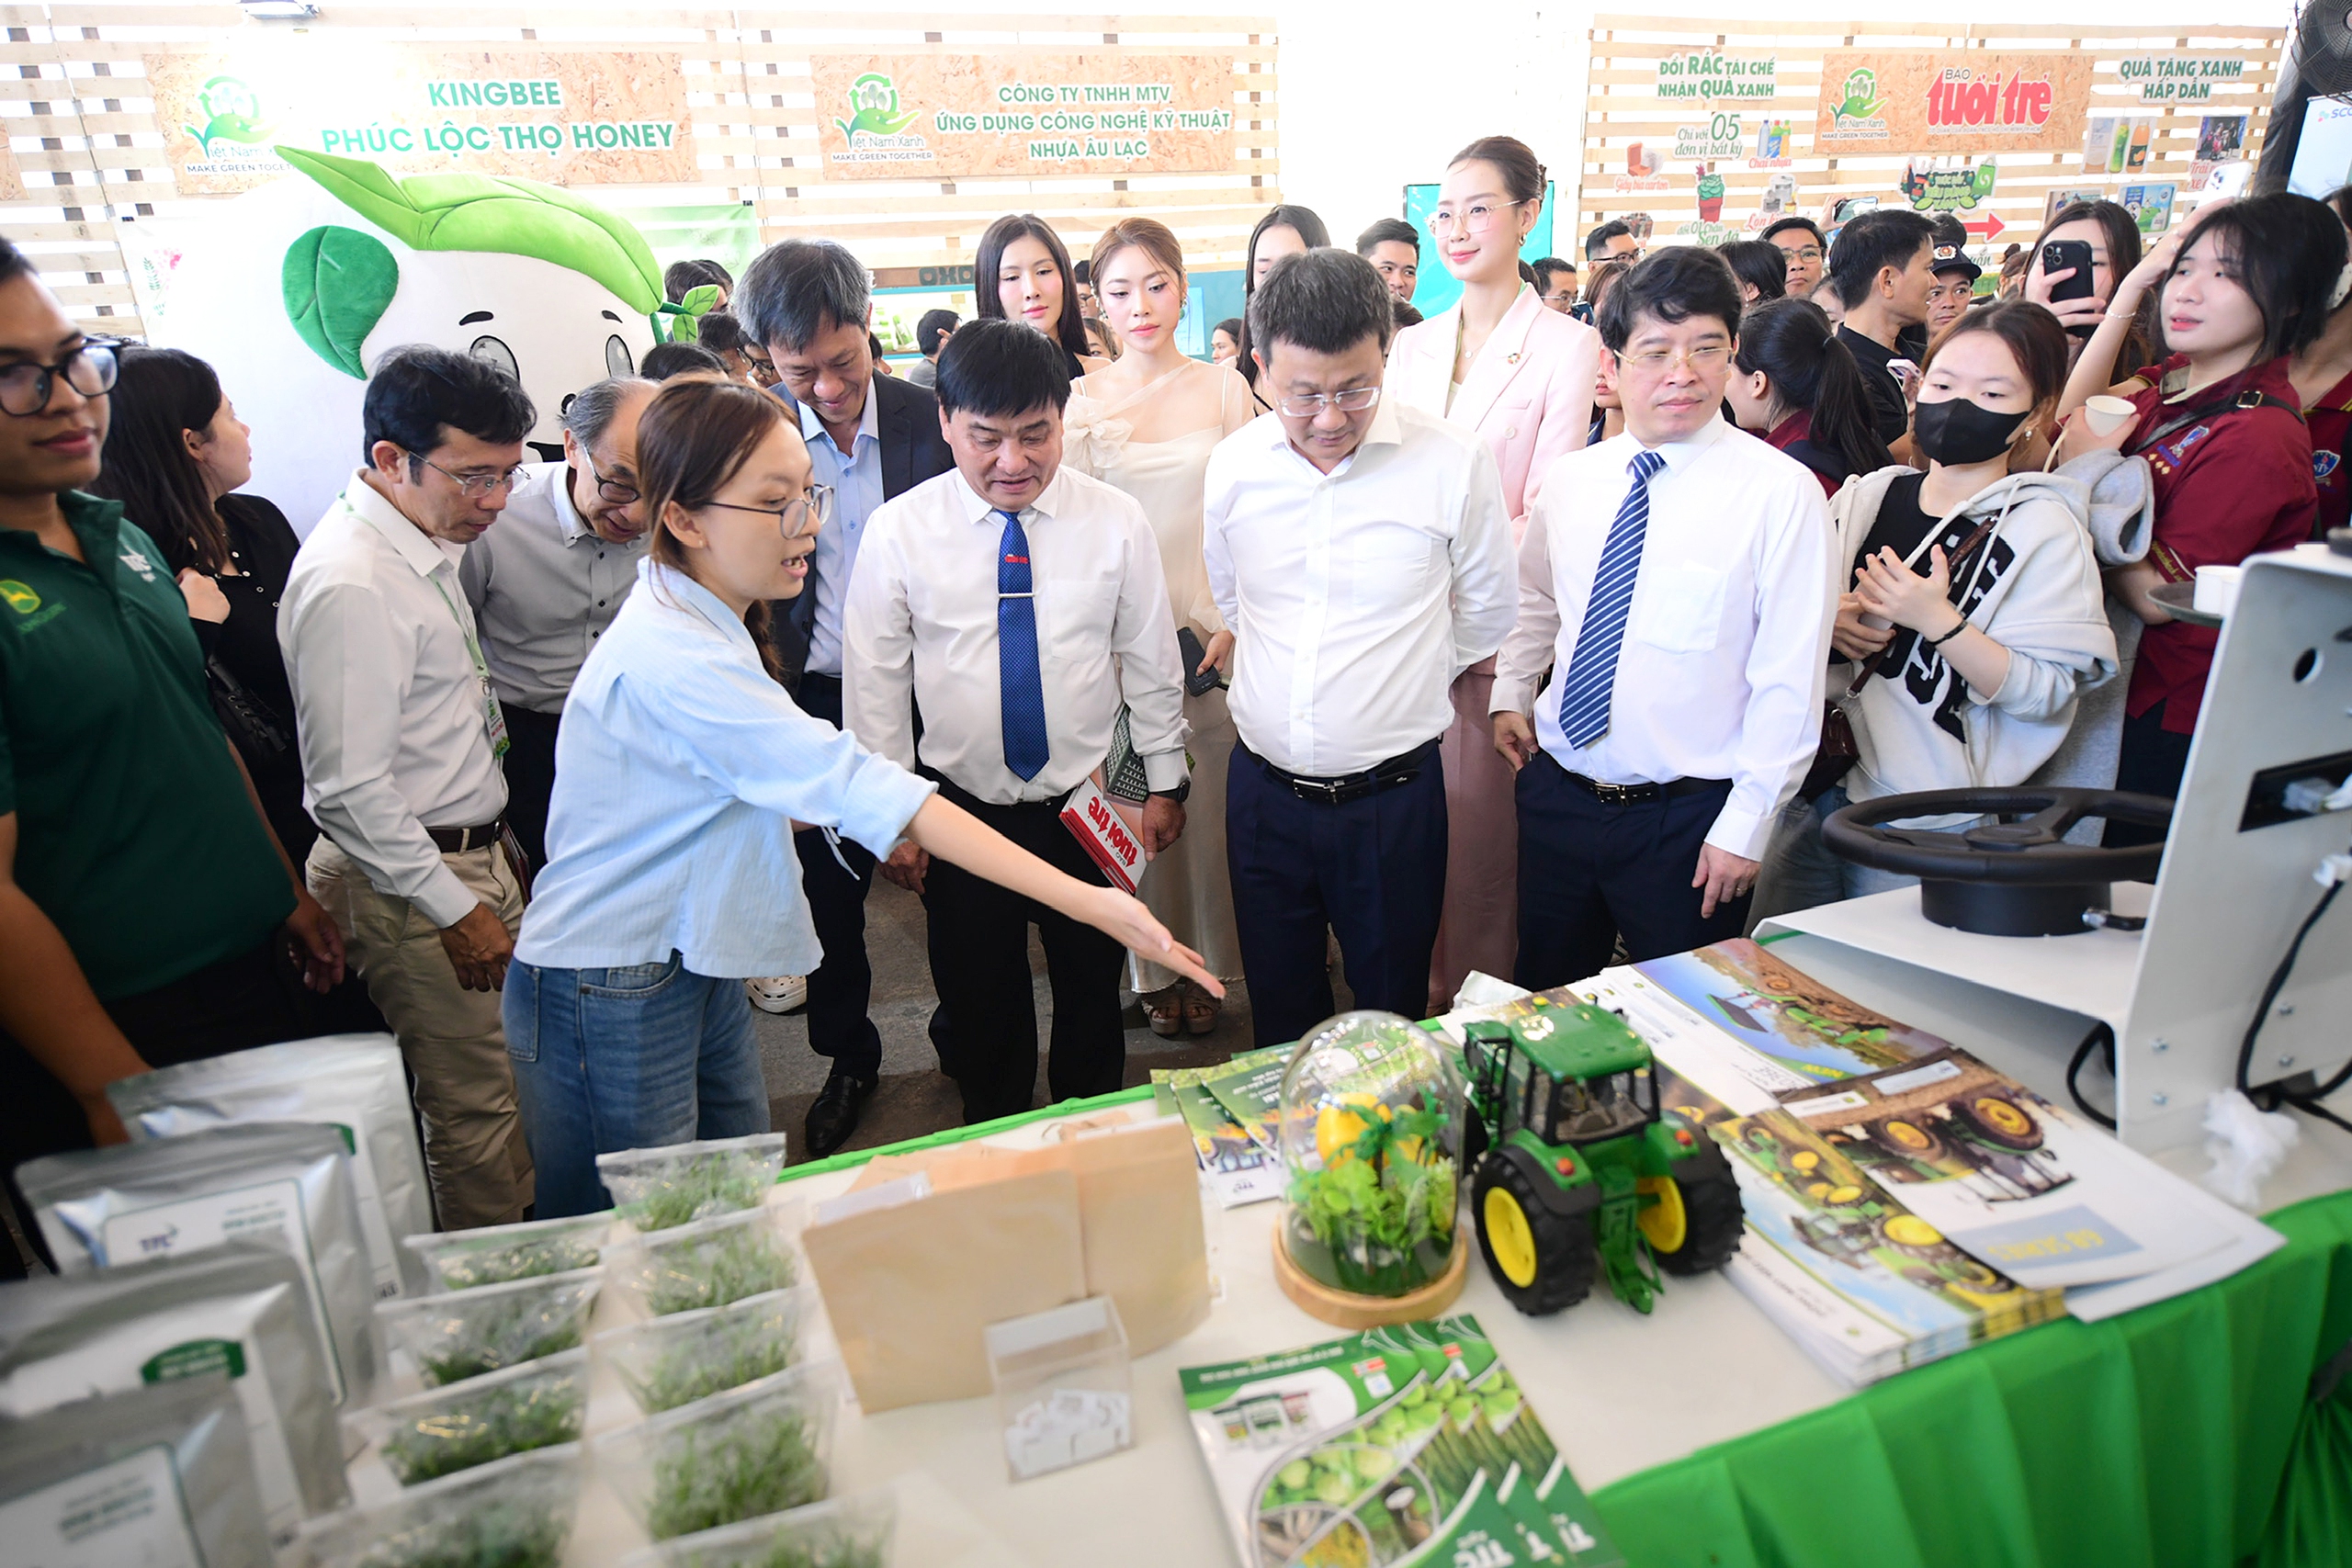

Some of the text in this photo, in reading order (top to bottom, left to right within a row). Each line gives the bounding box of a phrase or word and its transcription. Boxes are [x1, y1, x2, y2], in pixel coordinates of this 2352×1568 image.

[1688, 51, 1724, 75] RÁC
[1724, 59, 1747, 75] TÁI
[1749, 56, 1776, 75] CHẾ
[2120, 57, 2152, 80] QUÀ
[2199, 61, 2243, 77] XANH
[428, 82, 561, 107] KINGBEE
[999, 83, 1170, 102] CÔNG TY TNHH MTV
[1657, 76, 1775, 100] NHẬN QUÀ XANH
[2001, 69, 2052, 126] trẻ
[2143, 77, 2210, 98] HẤP DẪN
[936, 109, 1230, 135] ỨNG DỤNG CÔNG NGHỆ KỸ THUẬT
[1695, 128, 1709, 140] với
[1712, 113, 1740, 141] 05
[322, 120, 673, 157] PHÚC LỘC THỌ HONEY
[869, 137, 895, 148] Nam
[898, 135, 924, 148] Xanh
[1675, 142, 1697, 155] đơn
[1699, 141, 1708, 157] vị
[1710, 140, 1727, 155] bất
[859, 152, 888, 161] GREEN
[889, 152, 933, 160] TOGETHER
[1030, 138, 1148, 162] NHỰA ÂU LẠC
[187, 164, 218, 173] MAKE
[220, 164, 255, 172] GREEN
[1748, 157, 1769, 169] Chai
[1747, 213, 1767, 231] Lon
[1697, 231, 1720, 246] Sen
